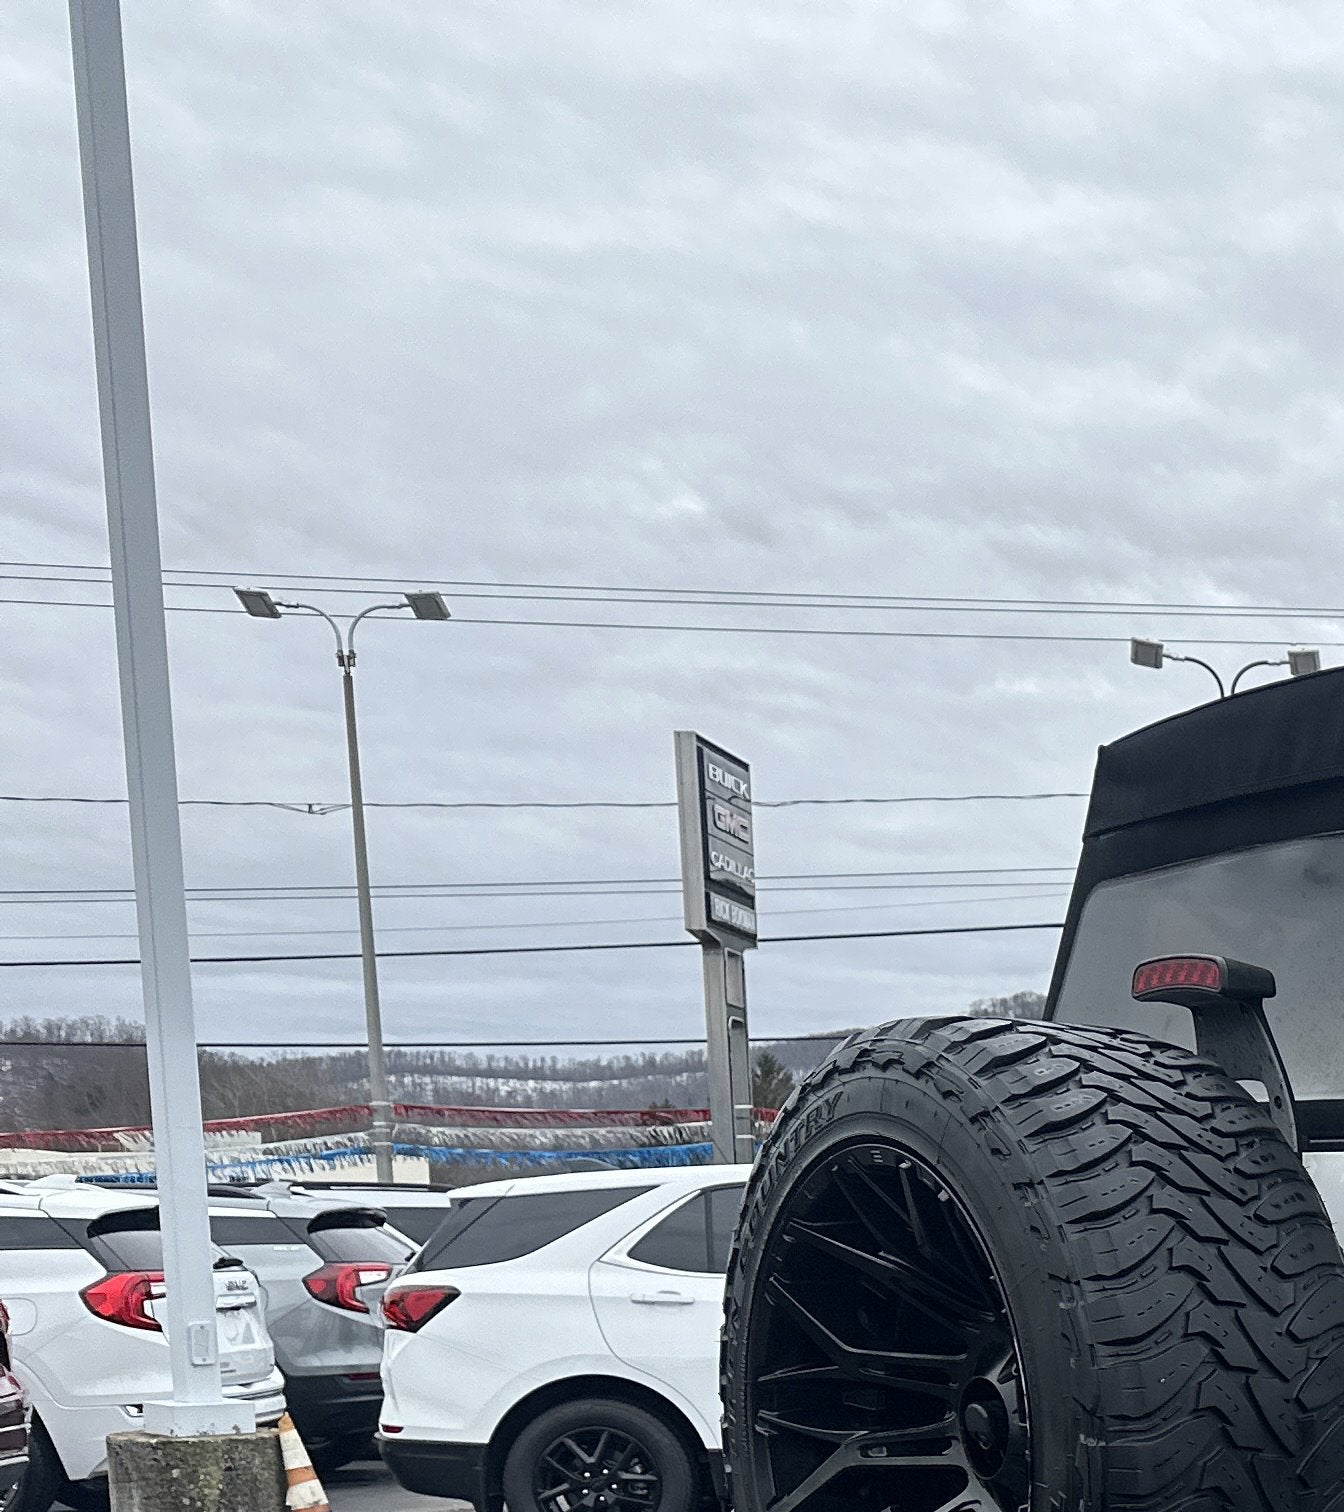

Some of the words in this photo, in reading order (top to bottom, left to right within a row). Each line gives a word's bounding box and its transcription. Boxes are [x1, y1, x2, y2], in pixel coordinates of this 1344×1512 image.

[708, 763, 750, 799] BUICK
[714, 804, 749, 842] GMC
[711, 851, 755, 883] CADILLAC
